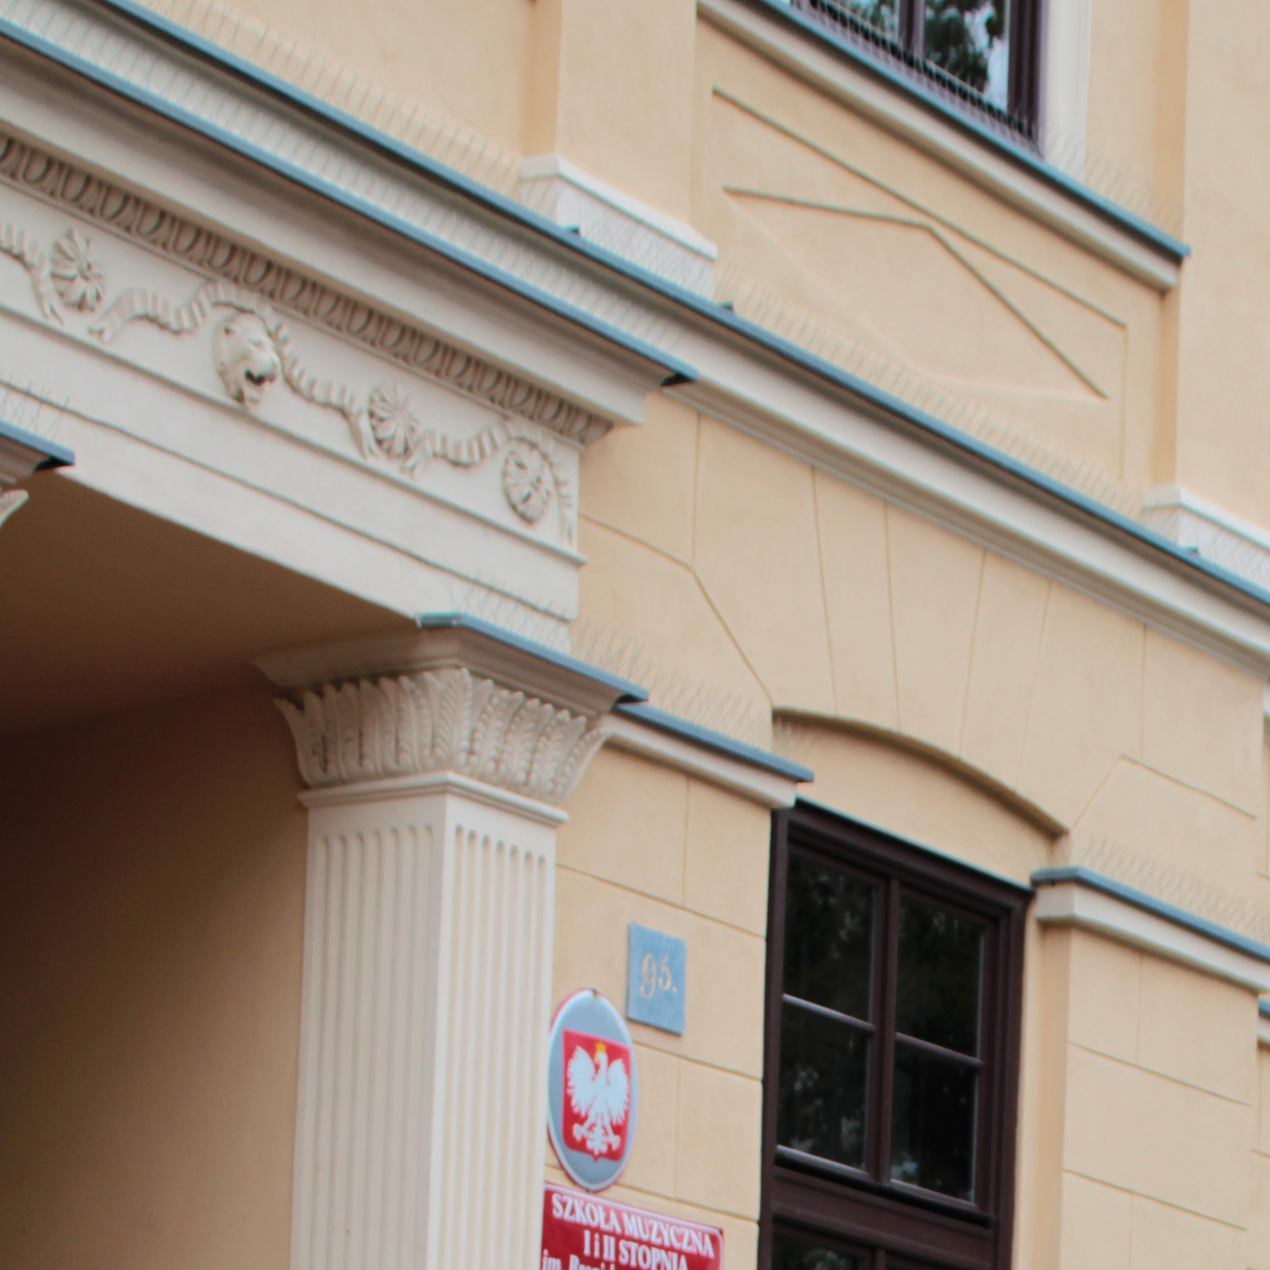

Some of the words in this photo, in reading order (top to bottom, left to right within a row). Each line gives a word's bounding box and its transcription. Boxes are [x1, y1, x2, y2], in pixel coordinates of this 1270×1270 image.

[552, 1192, 622, 1235] SZKOŁA
[622, 1211, 715, 1259] MUZYCZNA
[583, 1229, 591, 1256] I
[593, 1232, 600, 1259] i
[602, 1234, 616, 1262] II
